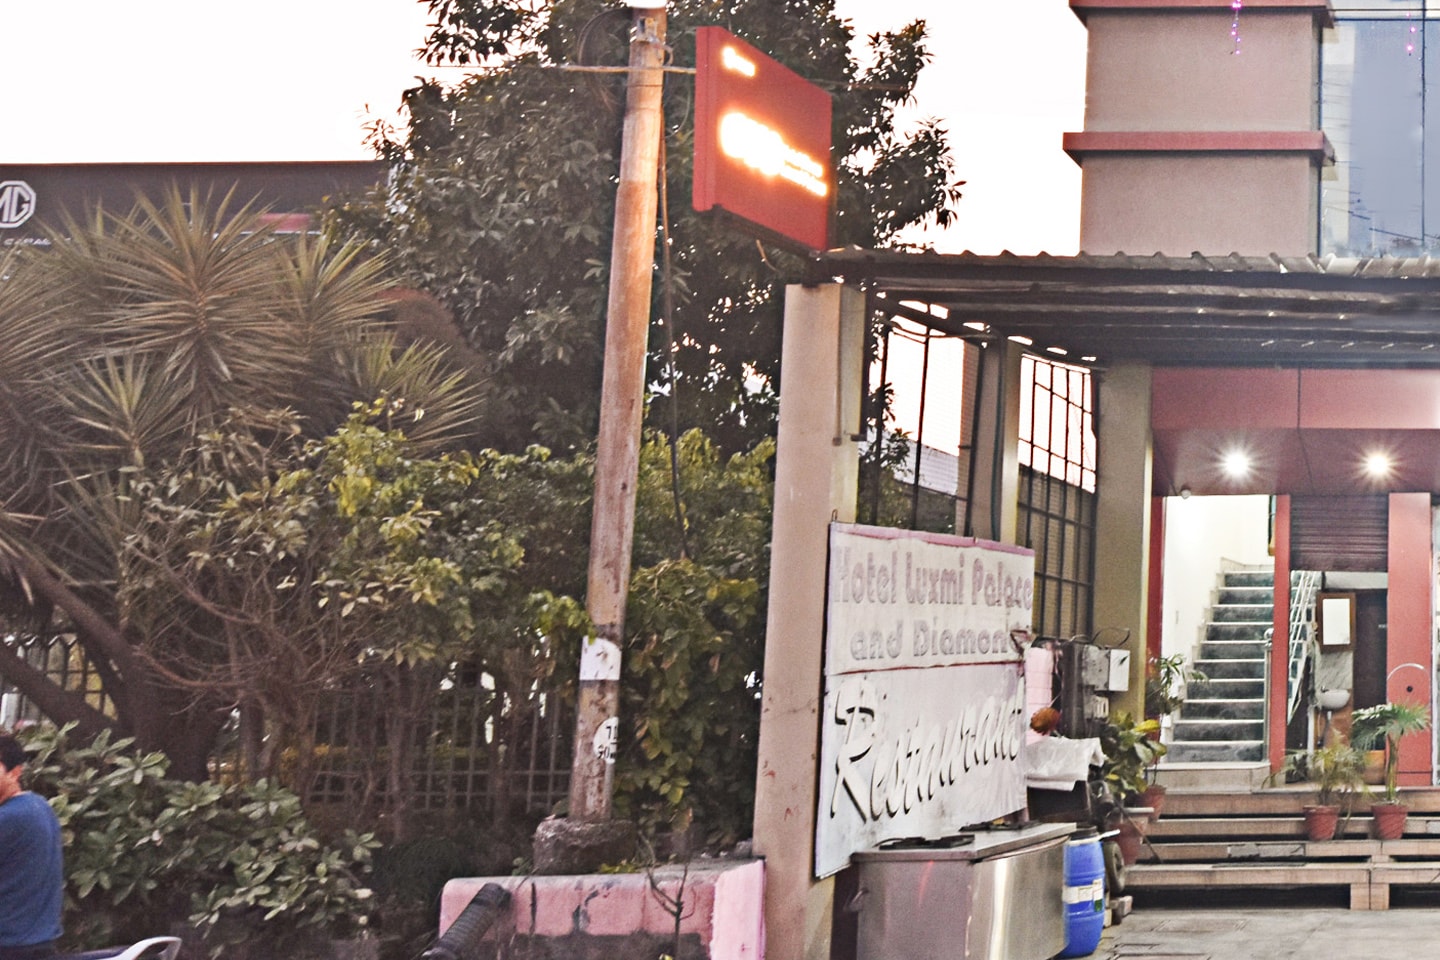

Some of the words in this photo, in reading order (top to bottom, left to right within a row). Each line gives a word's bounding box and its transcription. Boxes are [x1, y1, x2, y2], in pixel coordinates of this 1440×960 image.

[834, 546, 897, 604] Hotel
[905, 552, 966, 605] Luxmi
[971, 558, 1032, 610] Palace
[850, 620, 903, 660] and
